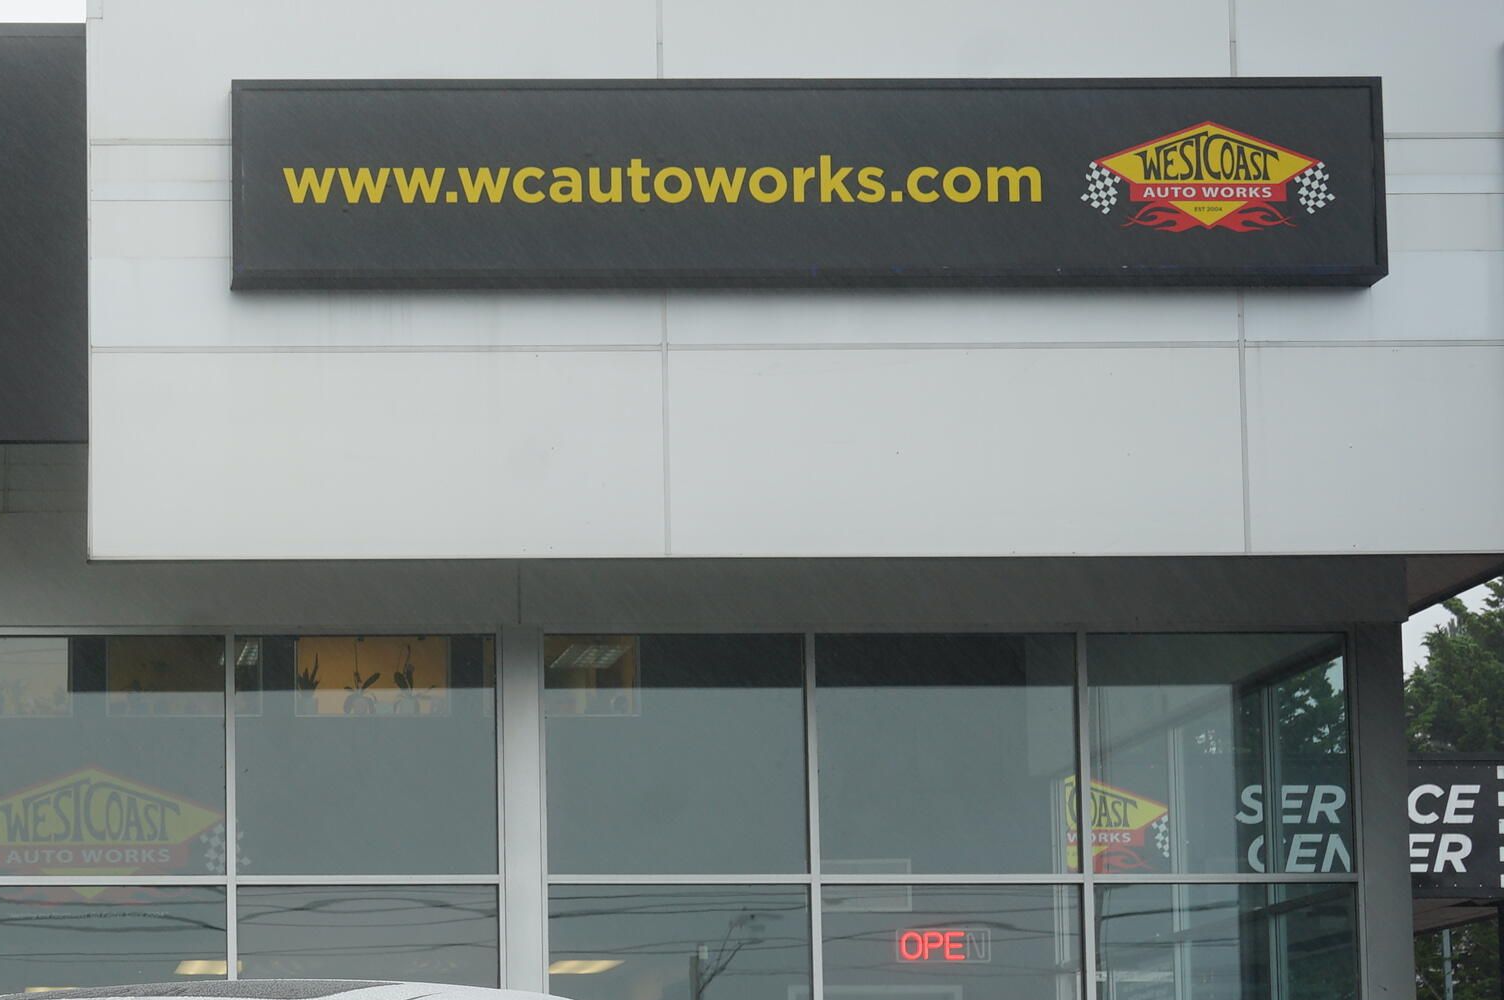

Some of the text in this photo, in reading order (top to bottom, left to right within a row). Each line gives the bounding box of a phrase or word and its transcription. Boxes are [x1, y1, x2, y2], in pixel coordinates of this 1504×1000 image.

[283, 155, 1042, 204] www.wcautoworks.com
[1143, 186, 1273, 198] AUTO WORKS
[6, 849, 171, 864] AUTO WORKS
[900, 930, 986, 960] OPEN
